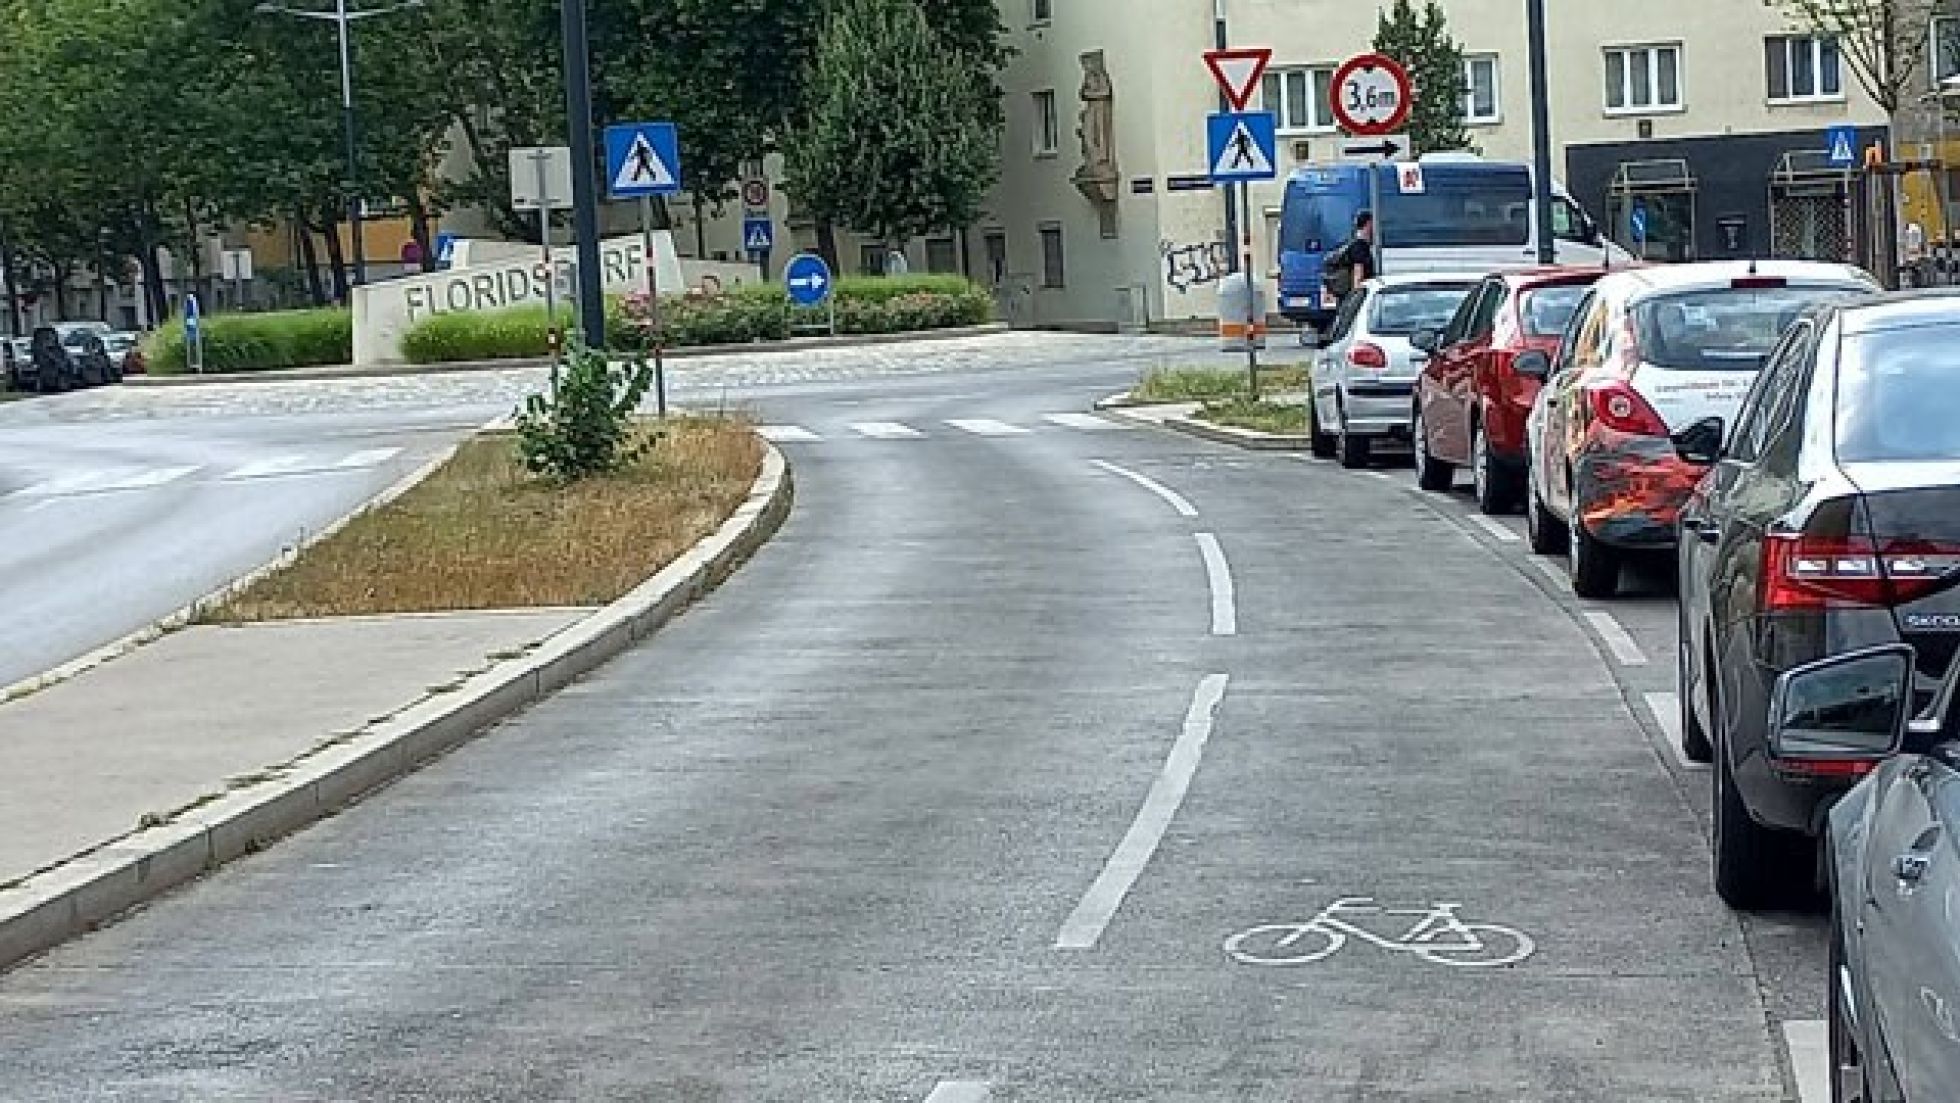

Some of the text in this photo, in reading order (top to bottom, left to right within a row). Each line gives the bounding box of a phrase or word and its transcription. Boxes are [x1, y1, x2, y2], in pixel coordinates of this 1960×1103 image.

[1346, 80, 1396, 112] 3,6m
[404, 244, 642, 321] FLORIDSDRF
[1906, 614, 1960, 626] SKOD
